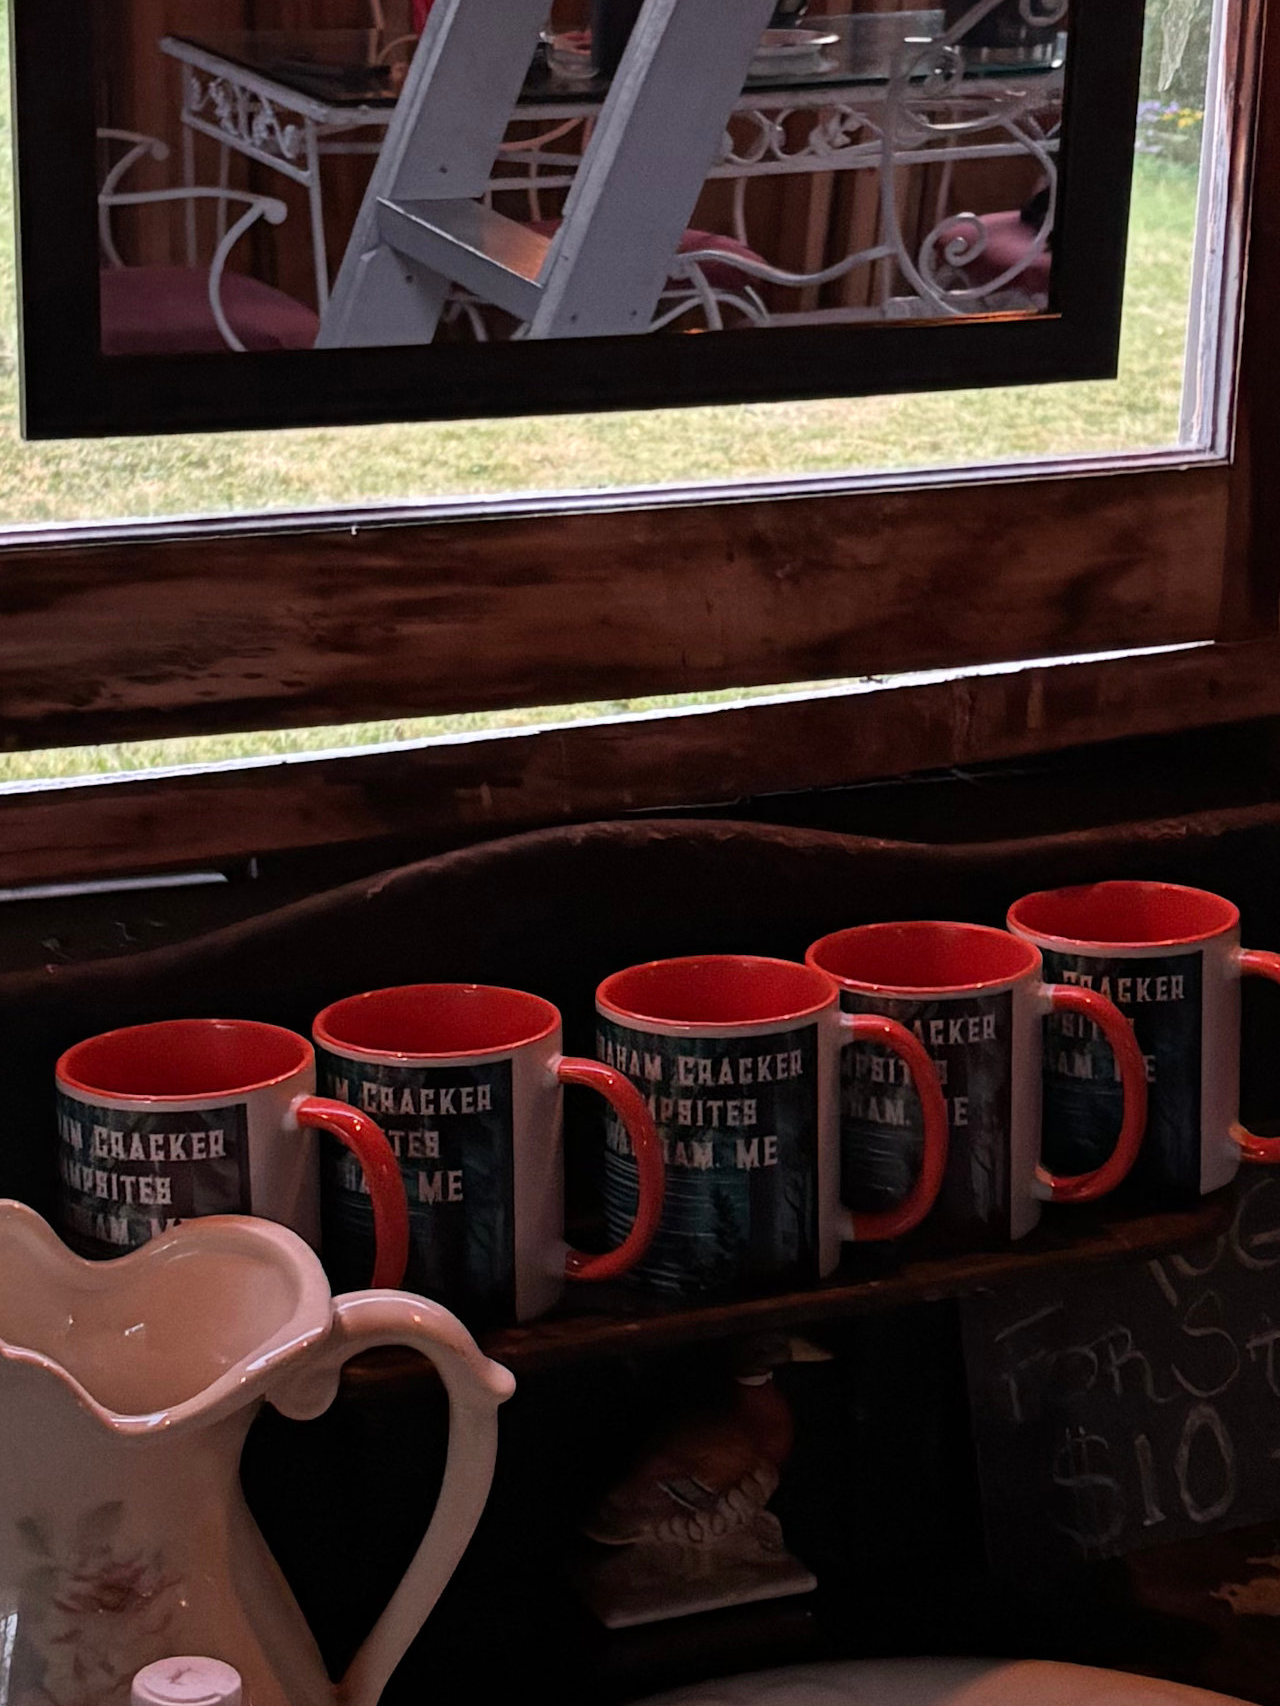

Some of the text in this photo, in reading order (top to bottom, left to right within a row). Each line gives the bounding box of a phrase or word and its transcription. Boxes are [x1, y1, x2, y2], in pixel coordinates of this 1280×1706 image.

[672, 1049, 804, 1086] CRACKER
[361, 1081, 493, 1116] CRACKER
[91, 1128, 227, 1161] CRACKER
[735, 1135, 779, 1171] ME
[416, 1169, 465, 1205] ME
